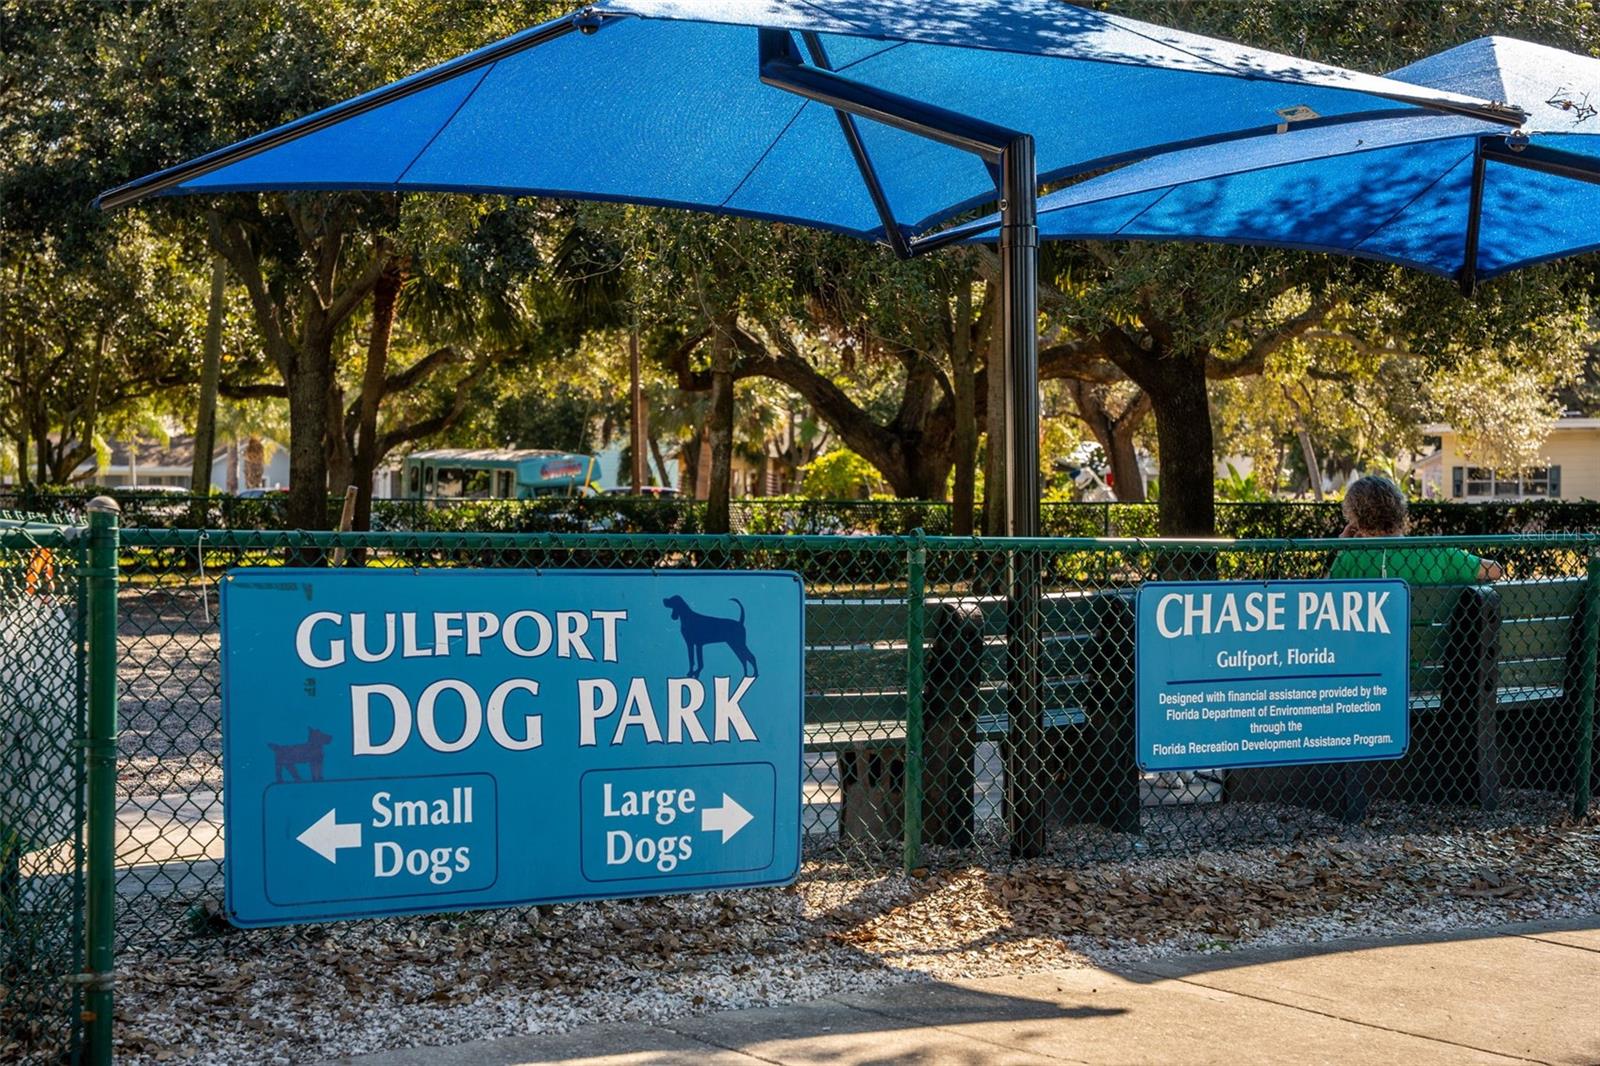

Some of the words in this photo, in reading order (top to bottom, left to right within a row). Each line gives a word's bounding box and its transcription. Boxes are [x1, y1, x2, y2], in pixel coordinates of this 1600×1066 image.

[1156, 592, 1286, 639] CHASE
[1298, 591, 1392, 634] PARK
[295, 610, 627, 668] GULFPORT
[1216, 651, 1283, 671] Gulfport,
[1287, 648, 1336, 665] Florida
[350, 678, 543, 756] DOG
[577, 676, 760, 747] PARK
[1159, 692, 1204, 707] Designed
[1206, 691, 1226, 703] with
[1227, 690, 1267, 702] financial
[1268, 688, 1317, 701] assistance
[1319, 686, 1359, 701] provided
[1360, 685, 1371, 699] by
[1373, 685, 1388, 696] the
[1166, 708, 1200, 721] Florida
[1201, 706, 1256, 722] Department
[1257, 705, 1269, 717] of
[1269, 703, 1334, 717] Environmental
[1335, 701, 1381, 713] Protection
[1152, 743, 1187, 756] Florida
[1188, 741, 1239, 754] Recreation
[1241, 737, 1301, 752] Development
[1302, 736, 1351, 749] Assistance
[1353, 733, 1394, 747] Program.
[1250, 721, 1286, 736] through
[1287, 720, 1303, 732] the
[371, 787, 473, 828] Small
[603, 783, 696, 825] Large
[374, 841, 471, 885] Dogs
[606, 830, 693, 872] Dogs
